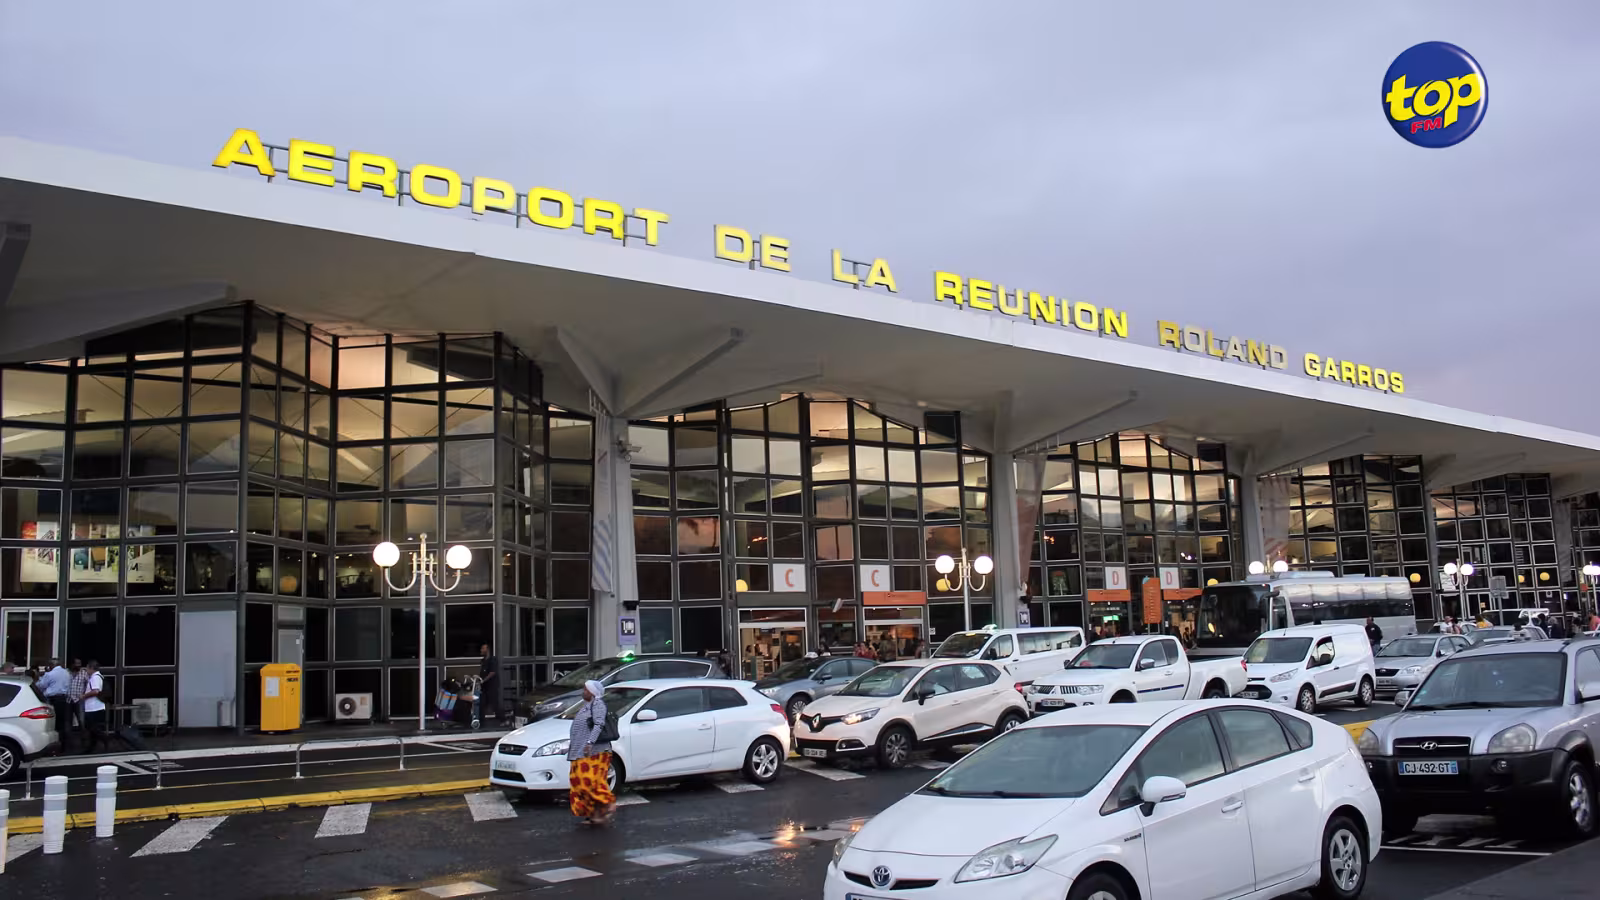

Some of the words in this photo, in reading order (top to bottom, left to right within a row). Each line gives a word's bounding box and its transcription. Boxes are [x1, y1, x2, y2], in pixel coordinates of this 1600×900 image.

[212, 127, 669, 247] AEROPORT
[713, 224, 791, 273] DE
[832, 248, 898, 293] LA
[934, 270, 1128, 339] REUNION
[1157, 319, 1289, 370] ROLAND
[1303, 352, 1405, 394] GARROS
[784, 568, 795, 588] C
[870, 569, 880, 588] C
[1112, 570, 1120, 586] D
[1165, 571, 1173, 586] D
